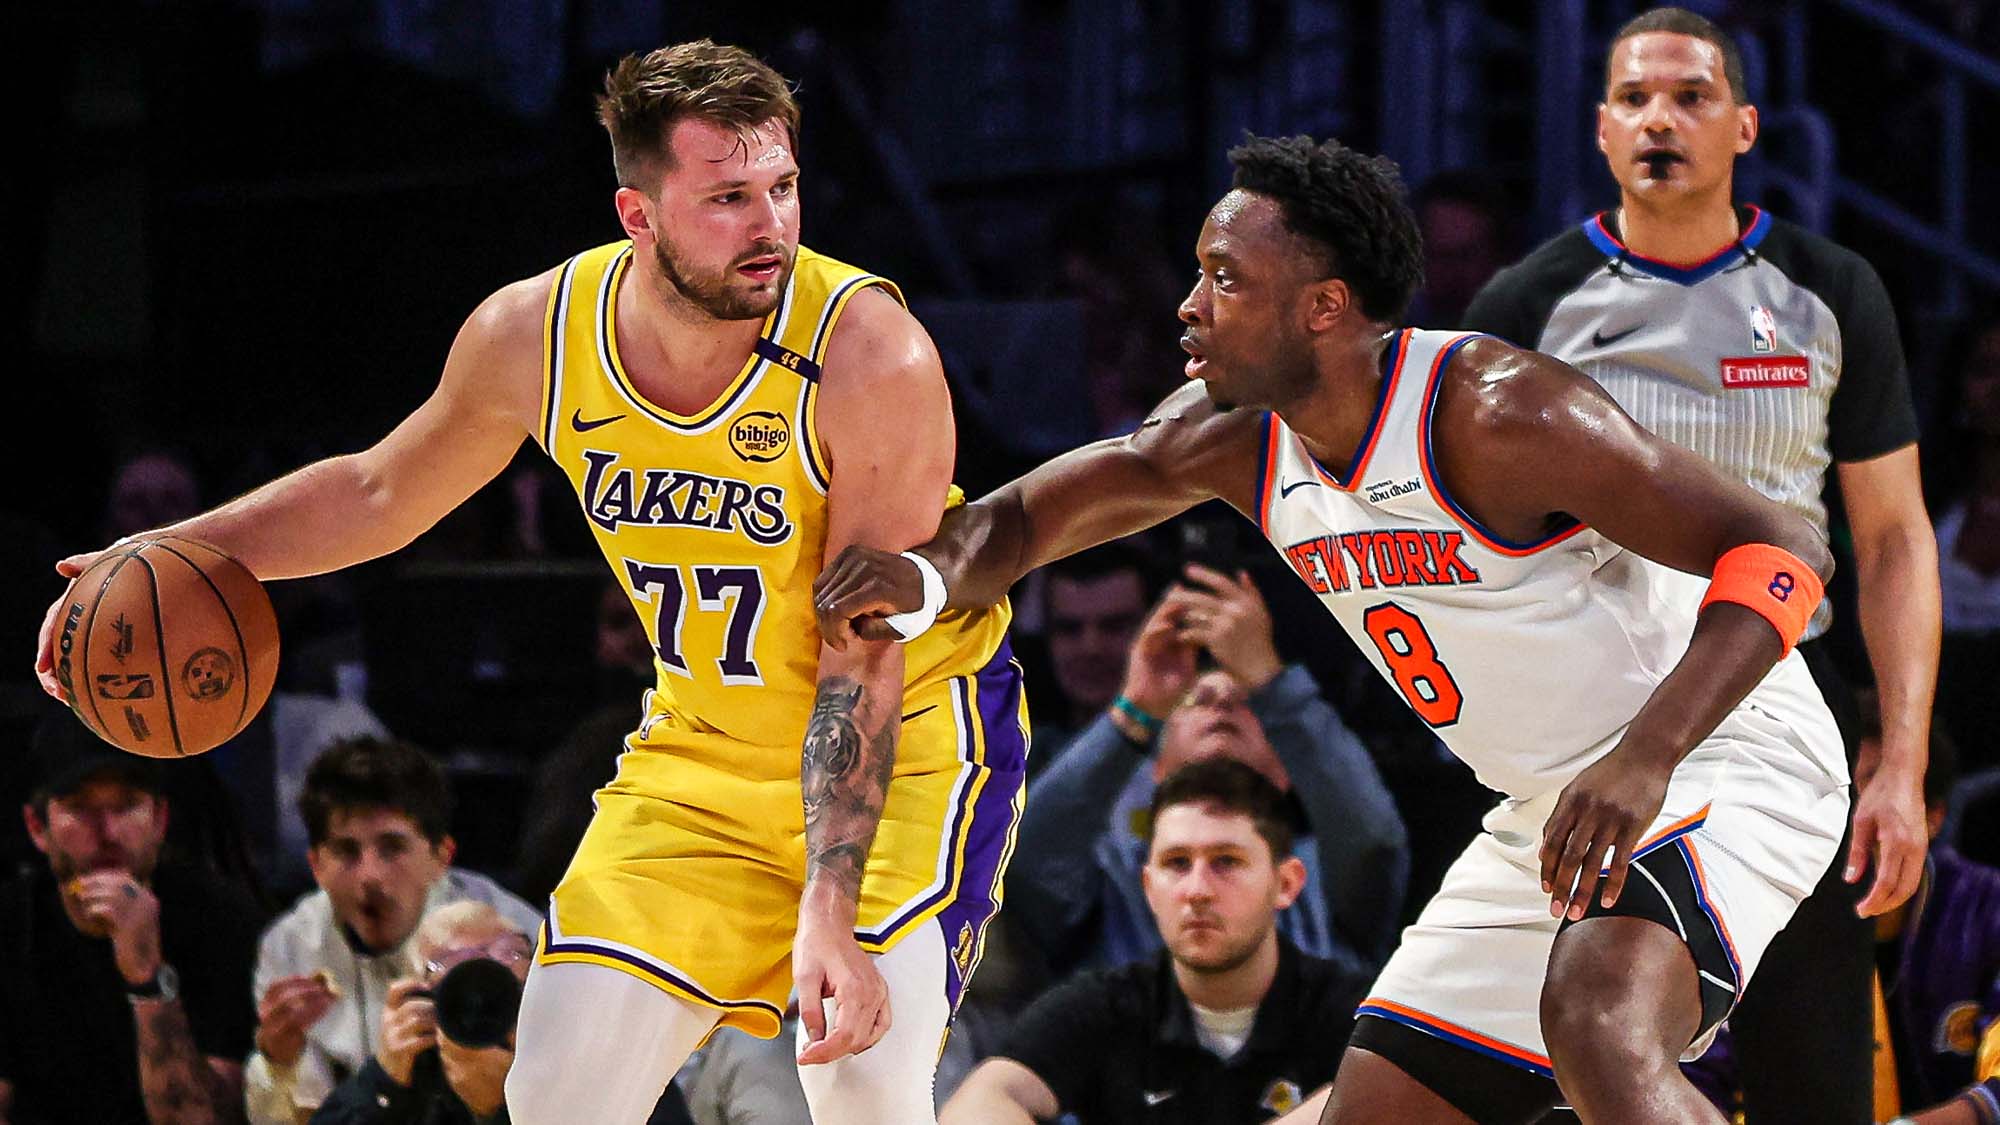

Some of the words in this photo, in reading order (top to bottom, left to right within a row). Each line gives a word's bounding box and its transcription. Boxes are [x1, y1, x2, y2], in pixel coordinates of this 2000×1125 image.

[781, 352, 800, 370] 44
[1724, 364, 1808, 383] Emirates
[736, 424, 787, 448] bibigo
[583, 449, 794, 546] LAKERS
[1369, 489, 1391, 503] abu
[1390, 477, 1422, 497] dhabi
[1341, 529, 1482, 589] YORK
[1768, 571, 1795, 603] 8
[621, 556, 766, 687] 77
[1363, 600, 1464, 729] 8
